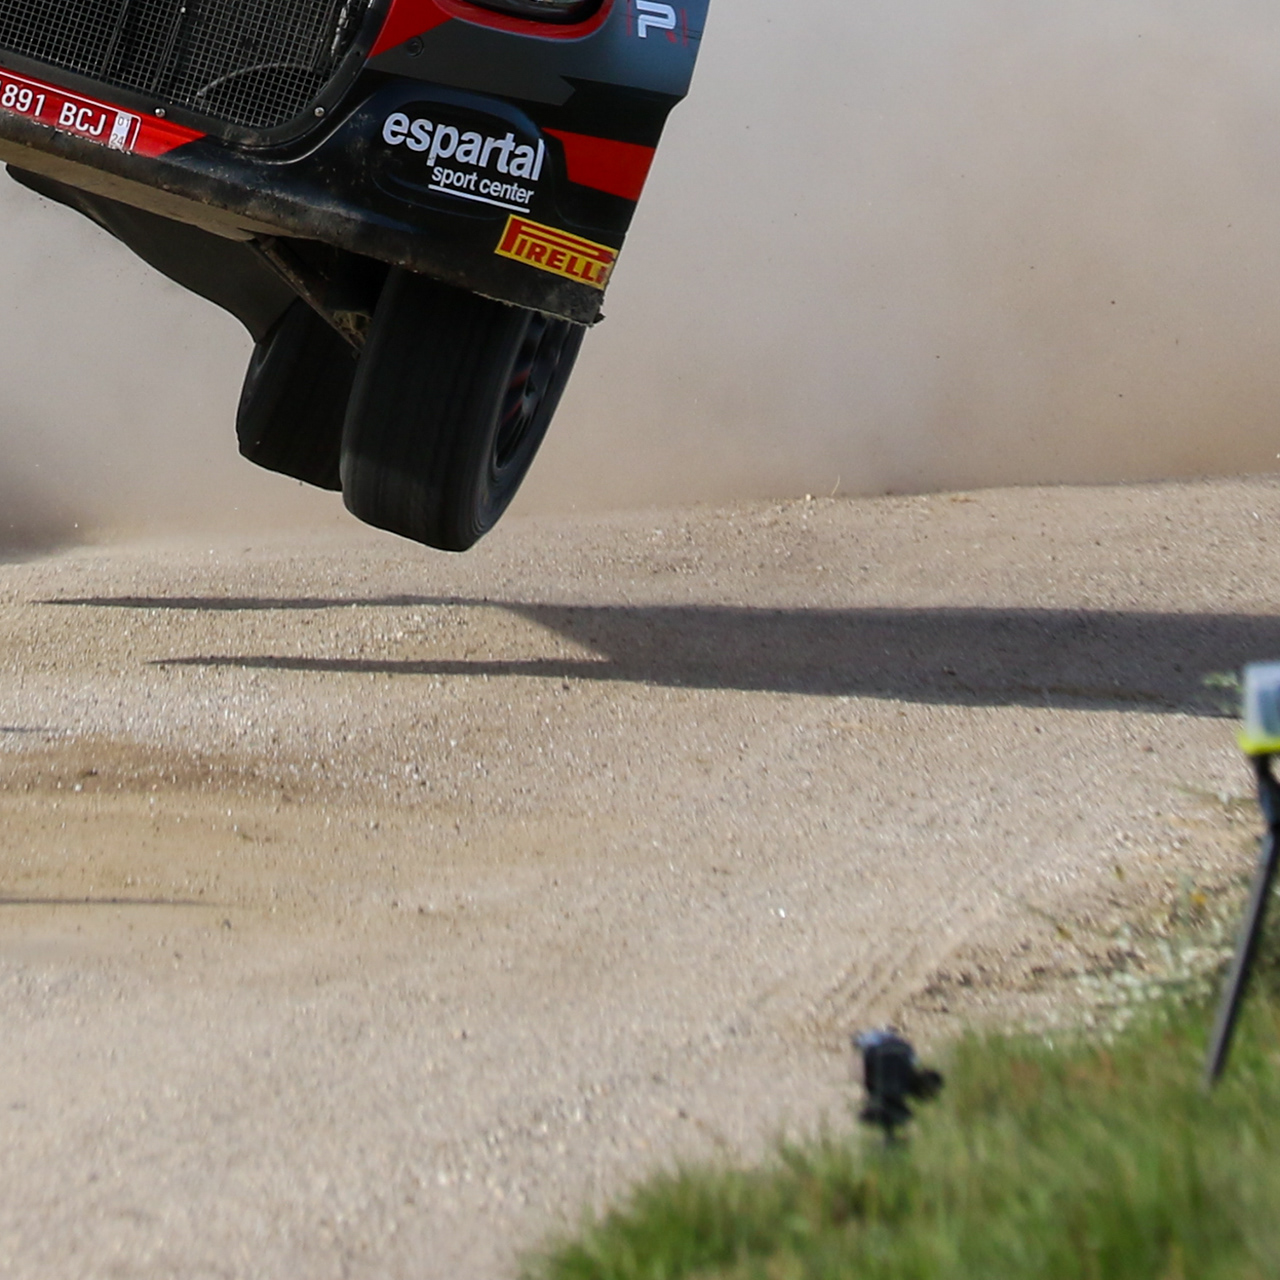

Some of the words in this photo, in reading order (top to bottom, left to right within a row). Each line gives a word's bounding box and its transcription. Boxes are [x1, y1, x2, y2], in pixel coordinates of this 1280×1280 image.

[58, 102, 107, 136] BCJ
[382, 111, 545, 181] espartal
[431, 165, 478, 191] sport
[478, 177, 534, 204] center
[500, 216, 616, 284] PIRELLI
